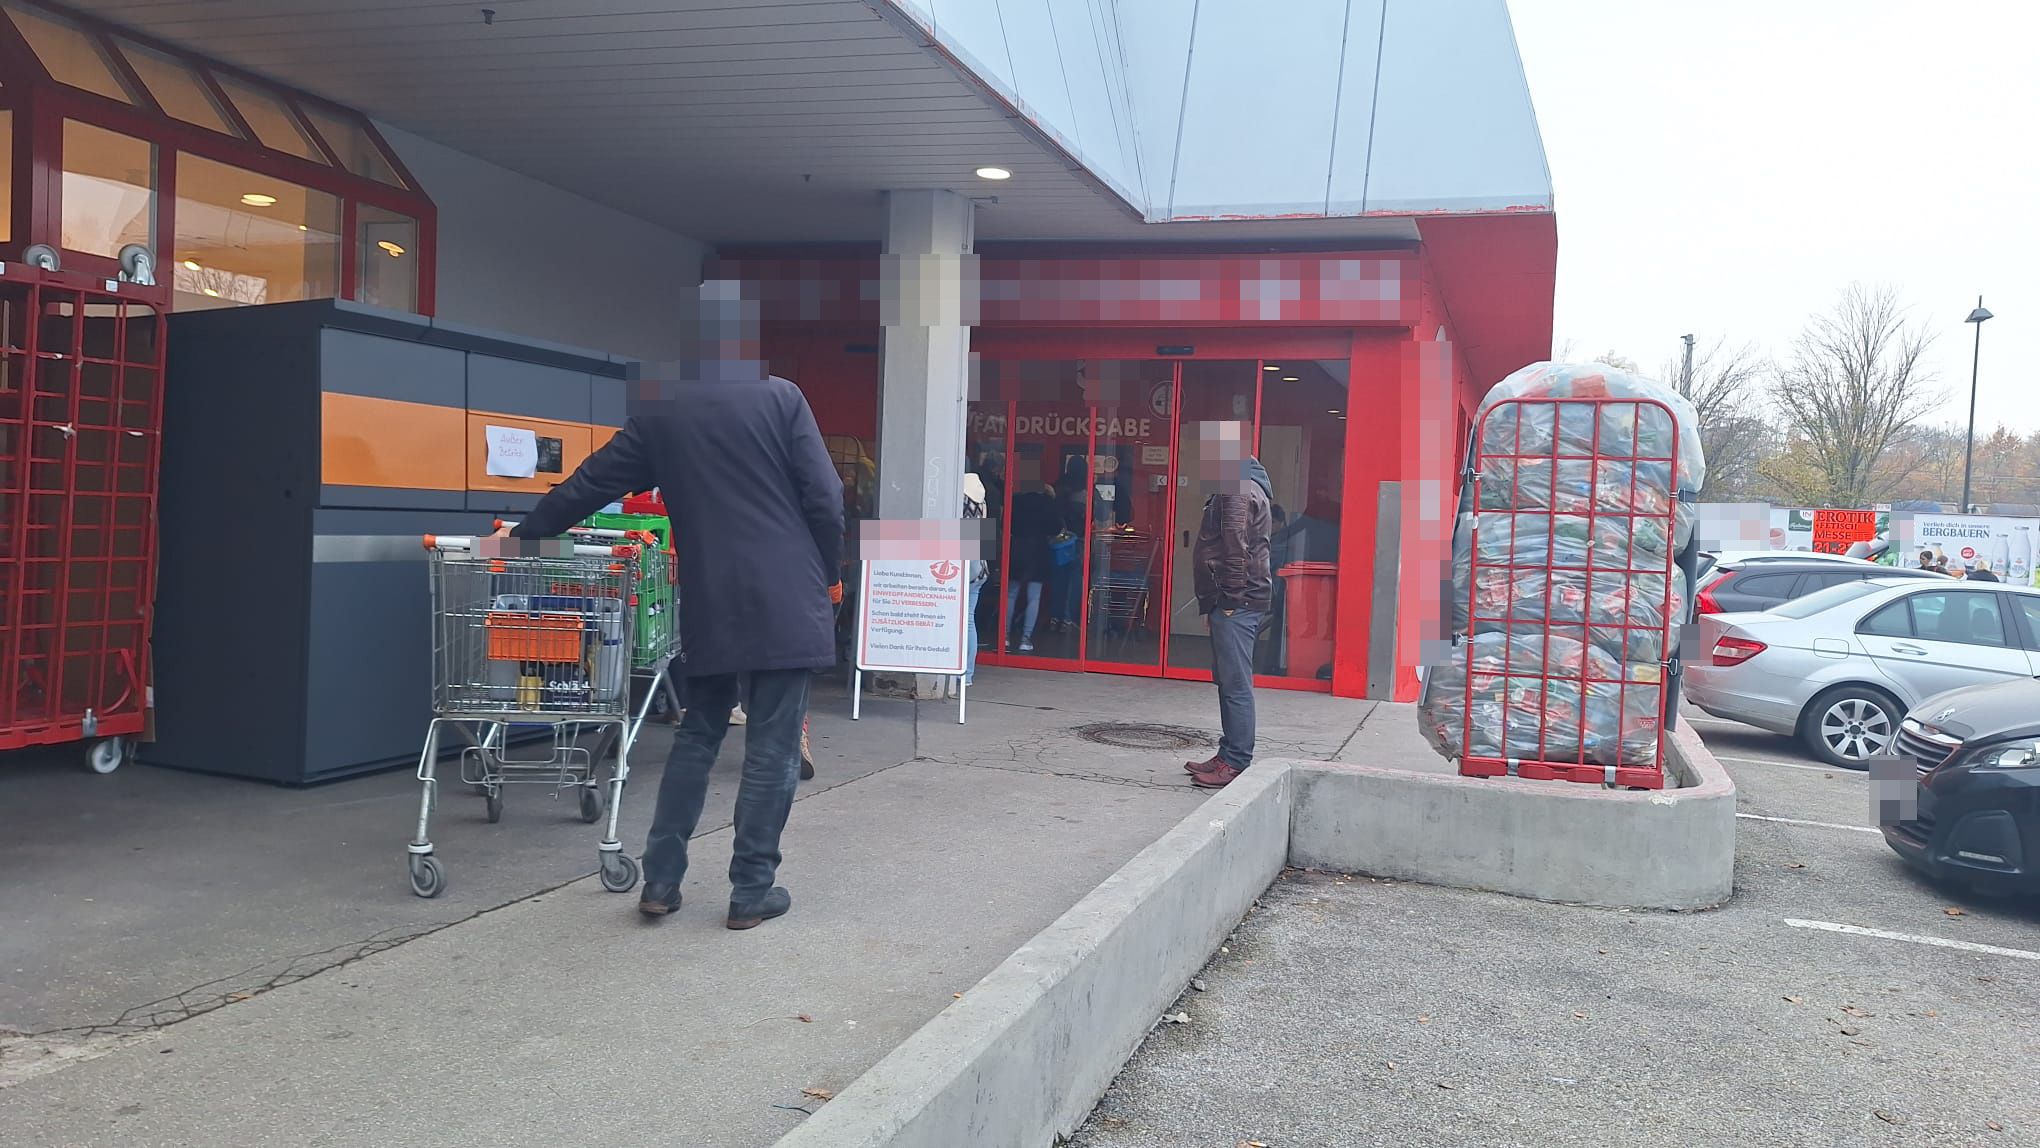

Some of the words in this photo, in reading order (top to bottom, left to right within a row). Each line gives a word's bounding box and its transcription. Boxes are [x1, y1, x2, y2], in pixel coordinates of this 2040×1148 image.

[1817, 511, 1873, 524] EROTIK
[1814, 530, 1851, 540] MESSE
[1922, 527, 1990, 538] BERGBAUERN
[872, 590, 957, 601] EINWEGPFANDRÜCKNAHME
[871, 618, 914, 627] ZUSÄTZLICHES
[915, 620, 934, 628] GERÄT
[870, 626, 904, 635] Verfügung.
